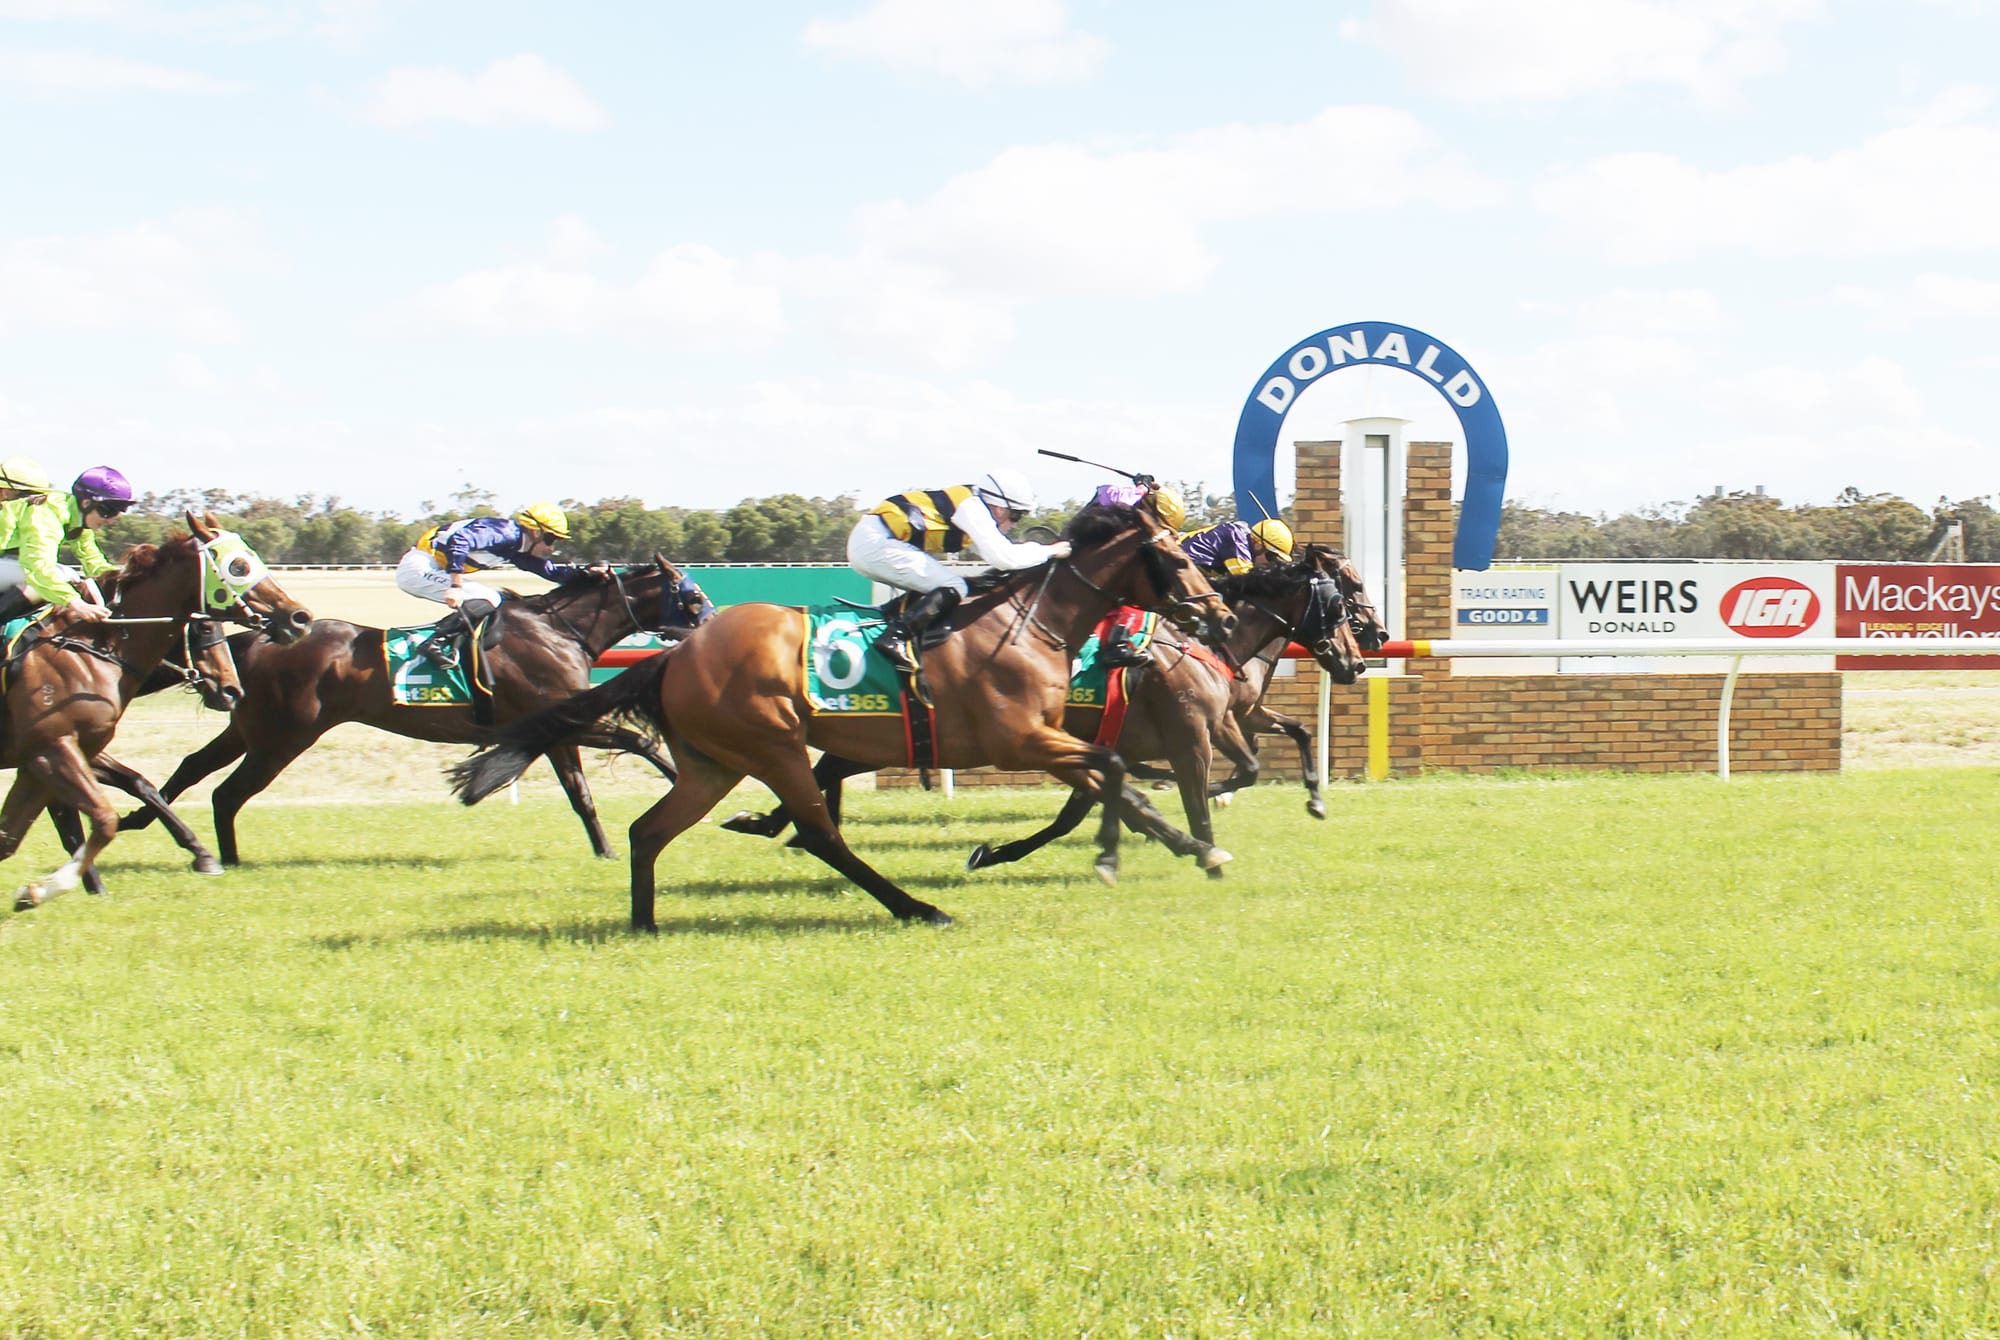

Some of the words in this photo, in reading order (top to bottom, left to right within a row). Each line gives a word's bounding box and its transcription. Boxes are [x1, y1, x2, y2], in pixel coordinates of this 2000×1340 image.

[1256, 330, 1481, 415] DONALD
[1460, 588, 1498, 600] TRACK
[1502, 588, 1545, 600] RATING
[1569, 580, 1698, 614] WEIRS
[1727, 589, 1812, 627] IGA
[1468, 609, 1524, 623] GOOD
[1525, 609, 1539, 623] 4
[1588, 621, 1676, 633] DONALD
[813, 619, 866, 690] 6
